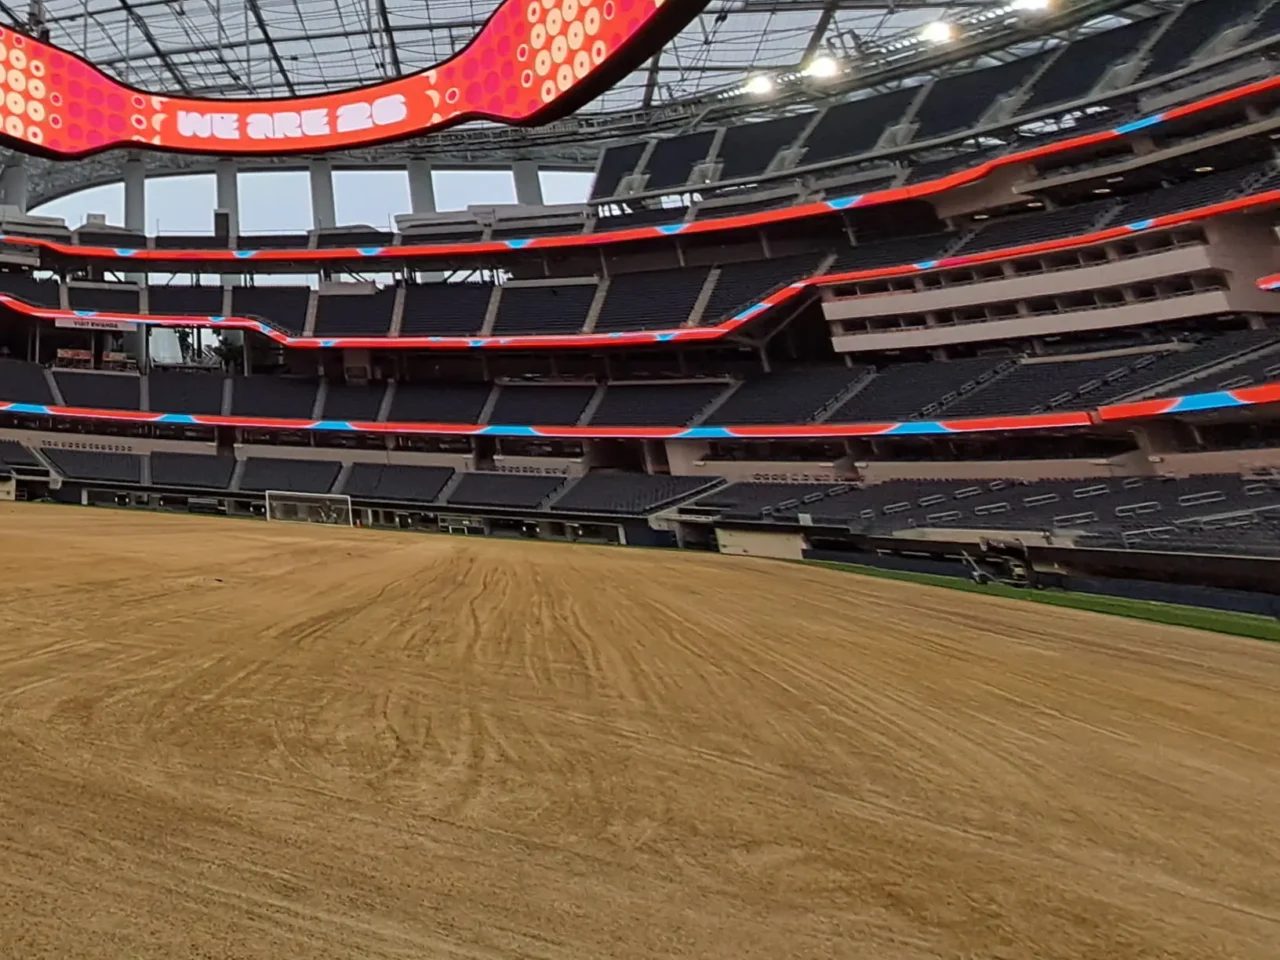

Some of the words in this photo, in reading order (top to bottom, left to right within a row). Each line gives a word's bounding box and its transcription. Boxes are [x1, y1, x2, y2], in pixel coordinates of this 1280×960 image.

[177, 110, 240, 139] WE
[246, 109, 331, 139] ARE
[336, 94, 407, 132] 26
